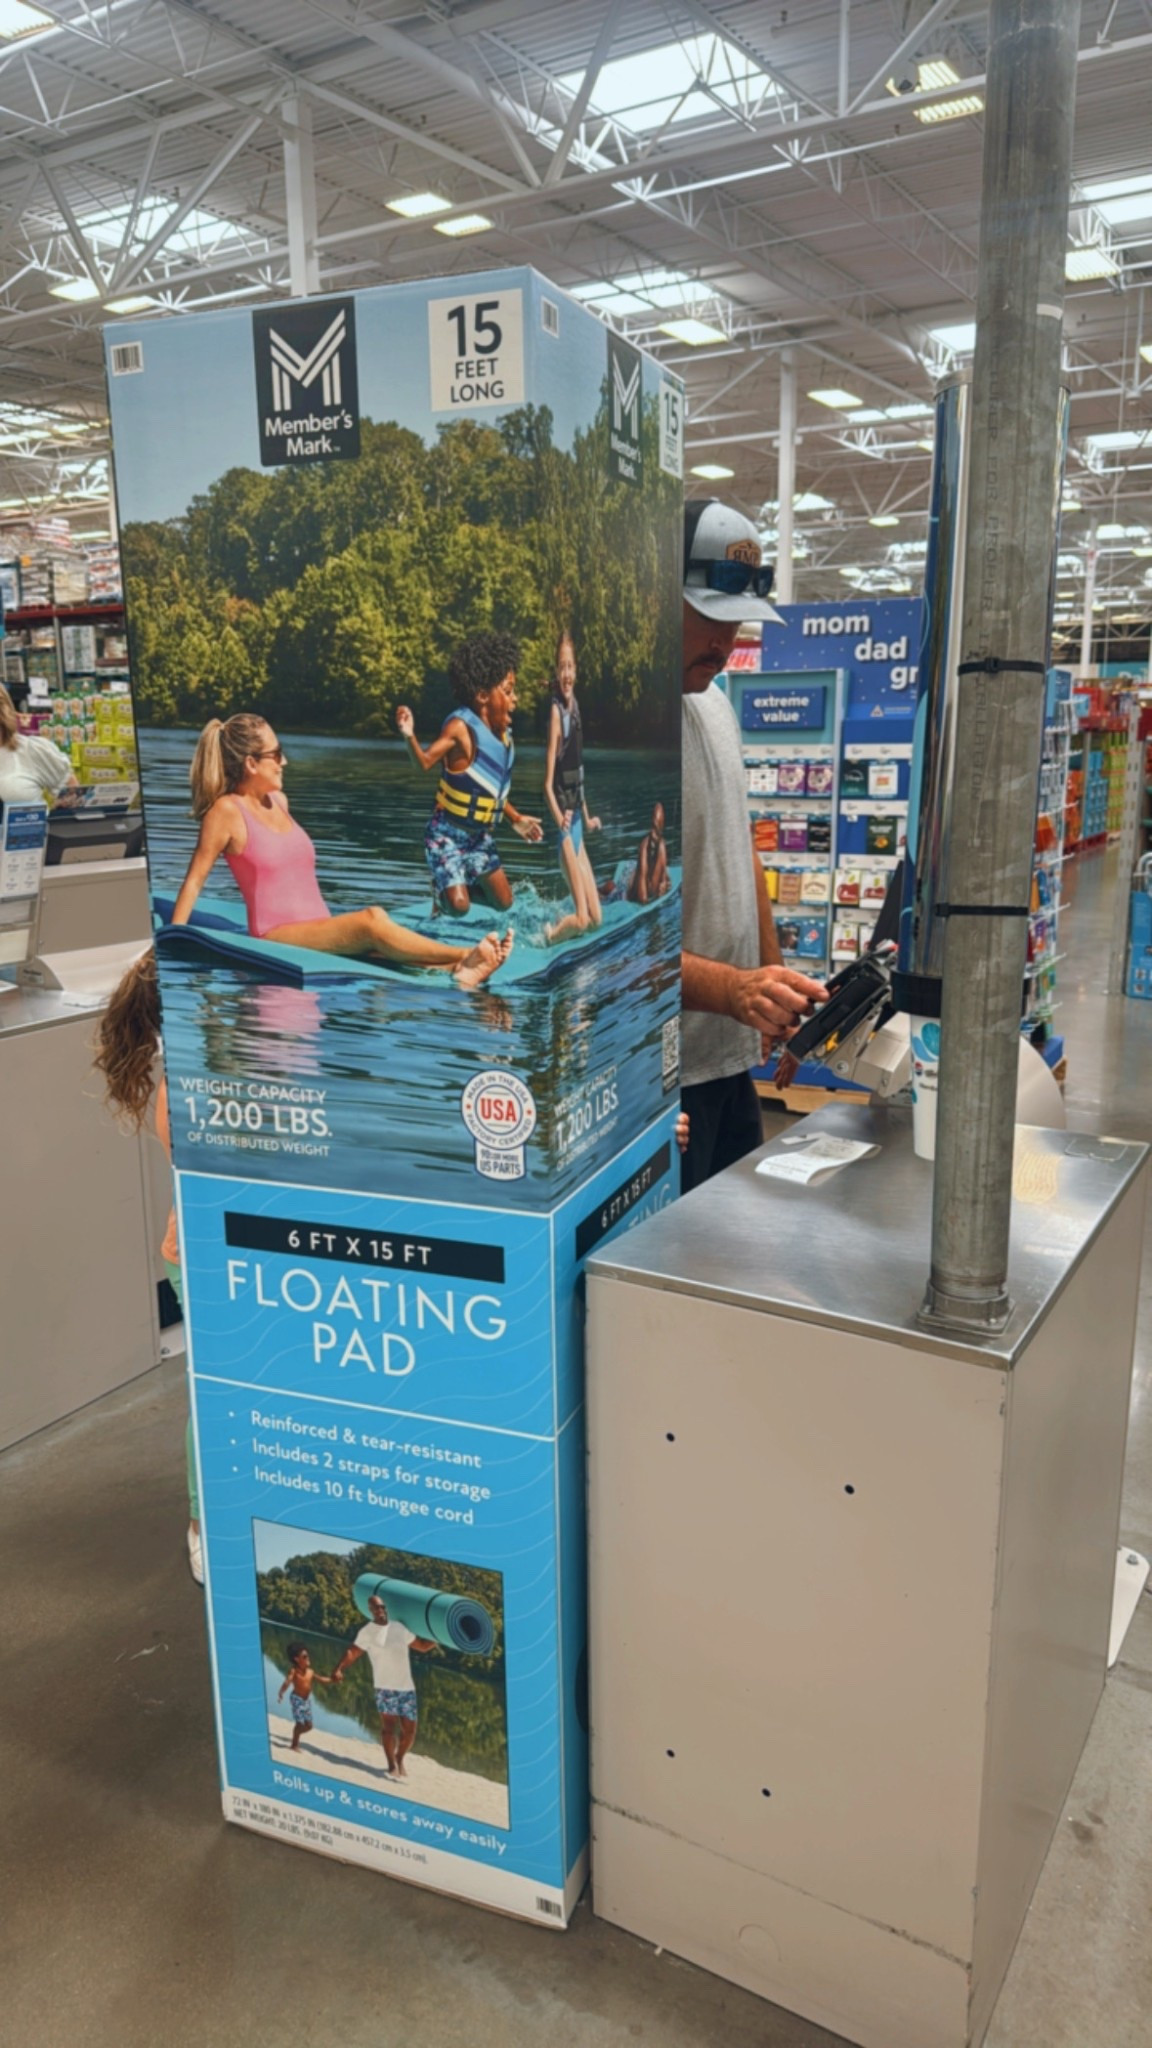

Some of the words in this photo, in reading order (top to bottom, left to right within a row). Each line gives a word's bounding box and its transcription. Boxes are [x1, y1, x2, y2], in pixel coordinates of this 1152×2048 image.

[447, 300, 502, 357] 15
[455, 358, 498, 380] FEET
[451, 381, 504, 404] LONG
[265, 409, 353, 437] Member's
[664, 391, 679, 436] 15
[286, 436, 332, 457] Mark
[802, 614, 869, 636] mom
[854, 636, 907, 661] dad
[753, 695, 810, 709] extreme
[762, 709, 800, 723] value
[179, 1076, 243, 1096] WEIGHT
[247, 1084, 326, 1105] CAPACITY
[466, 1079, 485, 1099] MADE
[498, 1075, 515, 1087] THE
[515, 1085, 528, 1104] USA
[184, 1096, 263, 1131] 1,200
[273, 1105, 333, 1137] LBS.
[480, 1098, 517, 1122] USA
[467, 1113, 497, 1145] FACTORY
[556, 1101, 592, 1153] 1,200
[187, 1131, 203, 1142] OF
[205, 1133, 279, 1151] DISTRIBUTED
[282, 1141, 330, 1157] WEIGHT
[480, 1160, 492, 1172] US
[493, 1161, 521, 1175] PARTS
[601, 1209, 608, 1228] 6
[610, 1198, 621, 1221] FT
[623, 1187, 630, 1207] X
[631, 1177, 641, 1199] 15
[641, 1167, 652, 1190] FT
[288, 1230, 300, 1248] 6
[310, 1232, 336, 1252] FT
[346, 1236, 361, 1256] X
[369, 1240, 393, 1260] 15
[404, 1244, 432, 1265] FT
[227, 1259, 507, 1341] FLOATING
[313, 1321, 416, 1377] PAD
[251, 1410, 337, 1440] Reinforced
[343, 1427, 357, 1444] &
[361, 1433, 482, 1469] tear-resistant
[252, 1437, 319, 1465] Includes
[323, 1451, 333, 1469] 2
[338, 1458, 390, 1482] straps
[395, 1465, 419, 1485] for
[425, 1475, 491, 1502] storage
[254, 1465, 320, 1494] Includes
[324, 1480, 343, 1498] 10
[348, 1484, 363, 1502] ft
[367, 1488, 429, 1517] bungee
[434, 1507, 474, 1526] cord
[273, 1769, 310, 1793] Rolls
[314, 1785, 335, 1803] up
[339, 1790, 352, 1806] &
[356, 1798, 407, 1823] stores
[412, 1814, 454, 1839] away
[458, 1828, 507, 1856] easily
